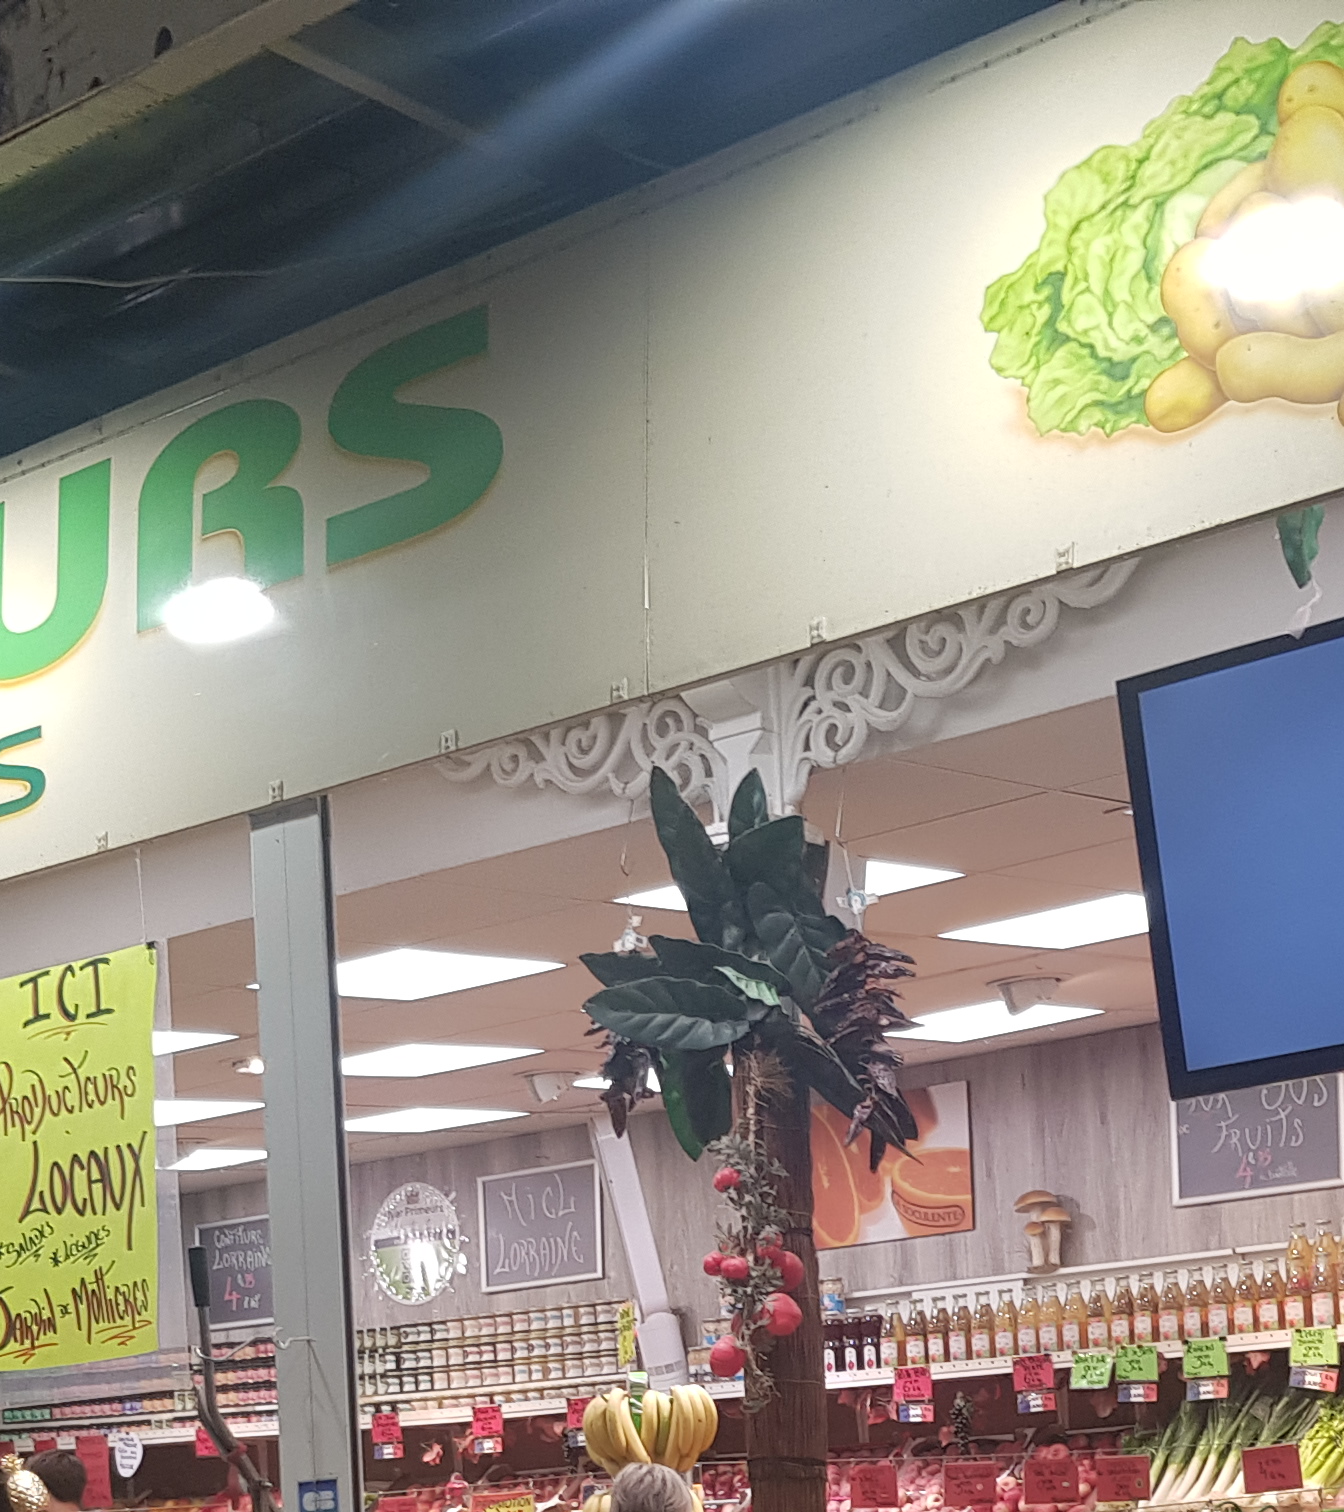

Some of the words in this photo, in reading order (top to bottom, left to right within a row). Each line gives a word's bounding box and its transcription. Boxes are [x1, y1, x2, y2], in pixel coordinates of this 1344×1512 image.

[20, 958, 115, 1028] ICI
[1211, 1106, 1303, 1156] FRUITS
[19, 1131, 147, 1251] LOCAUX
[494, 1222, 584, 1277] LORRAINE
